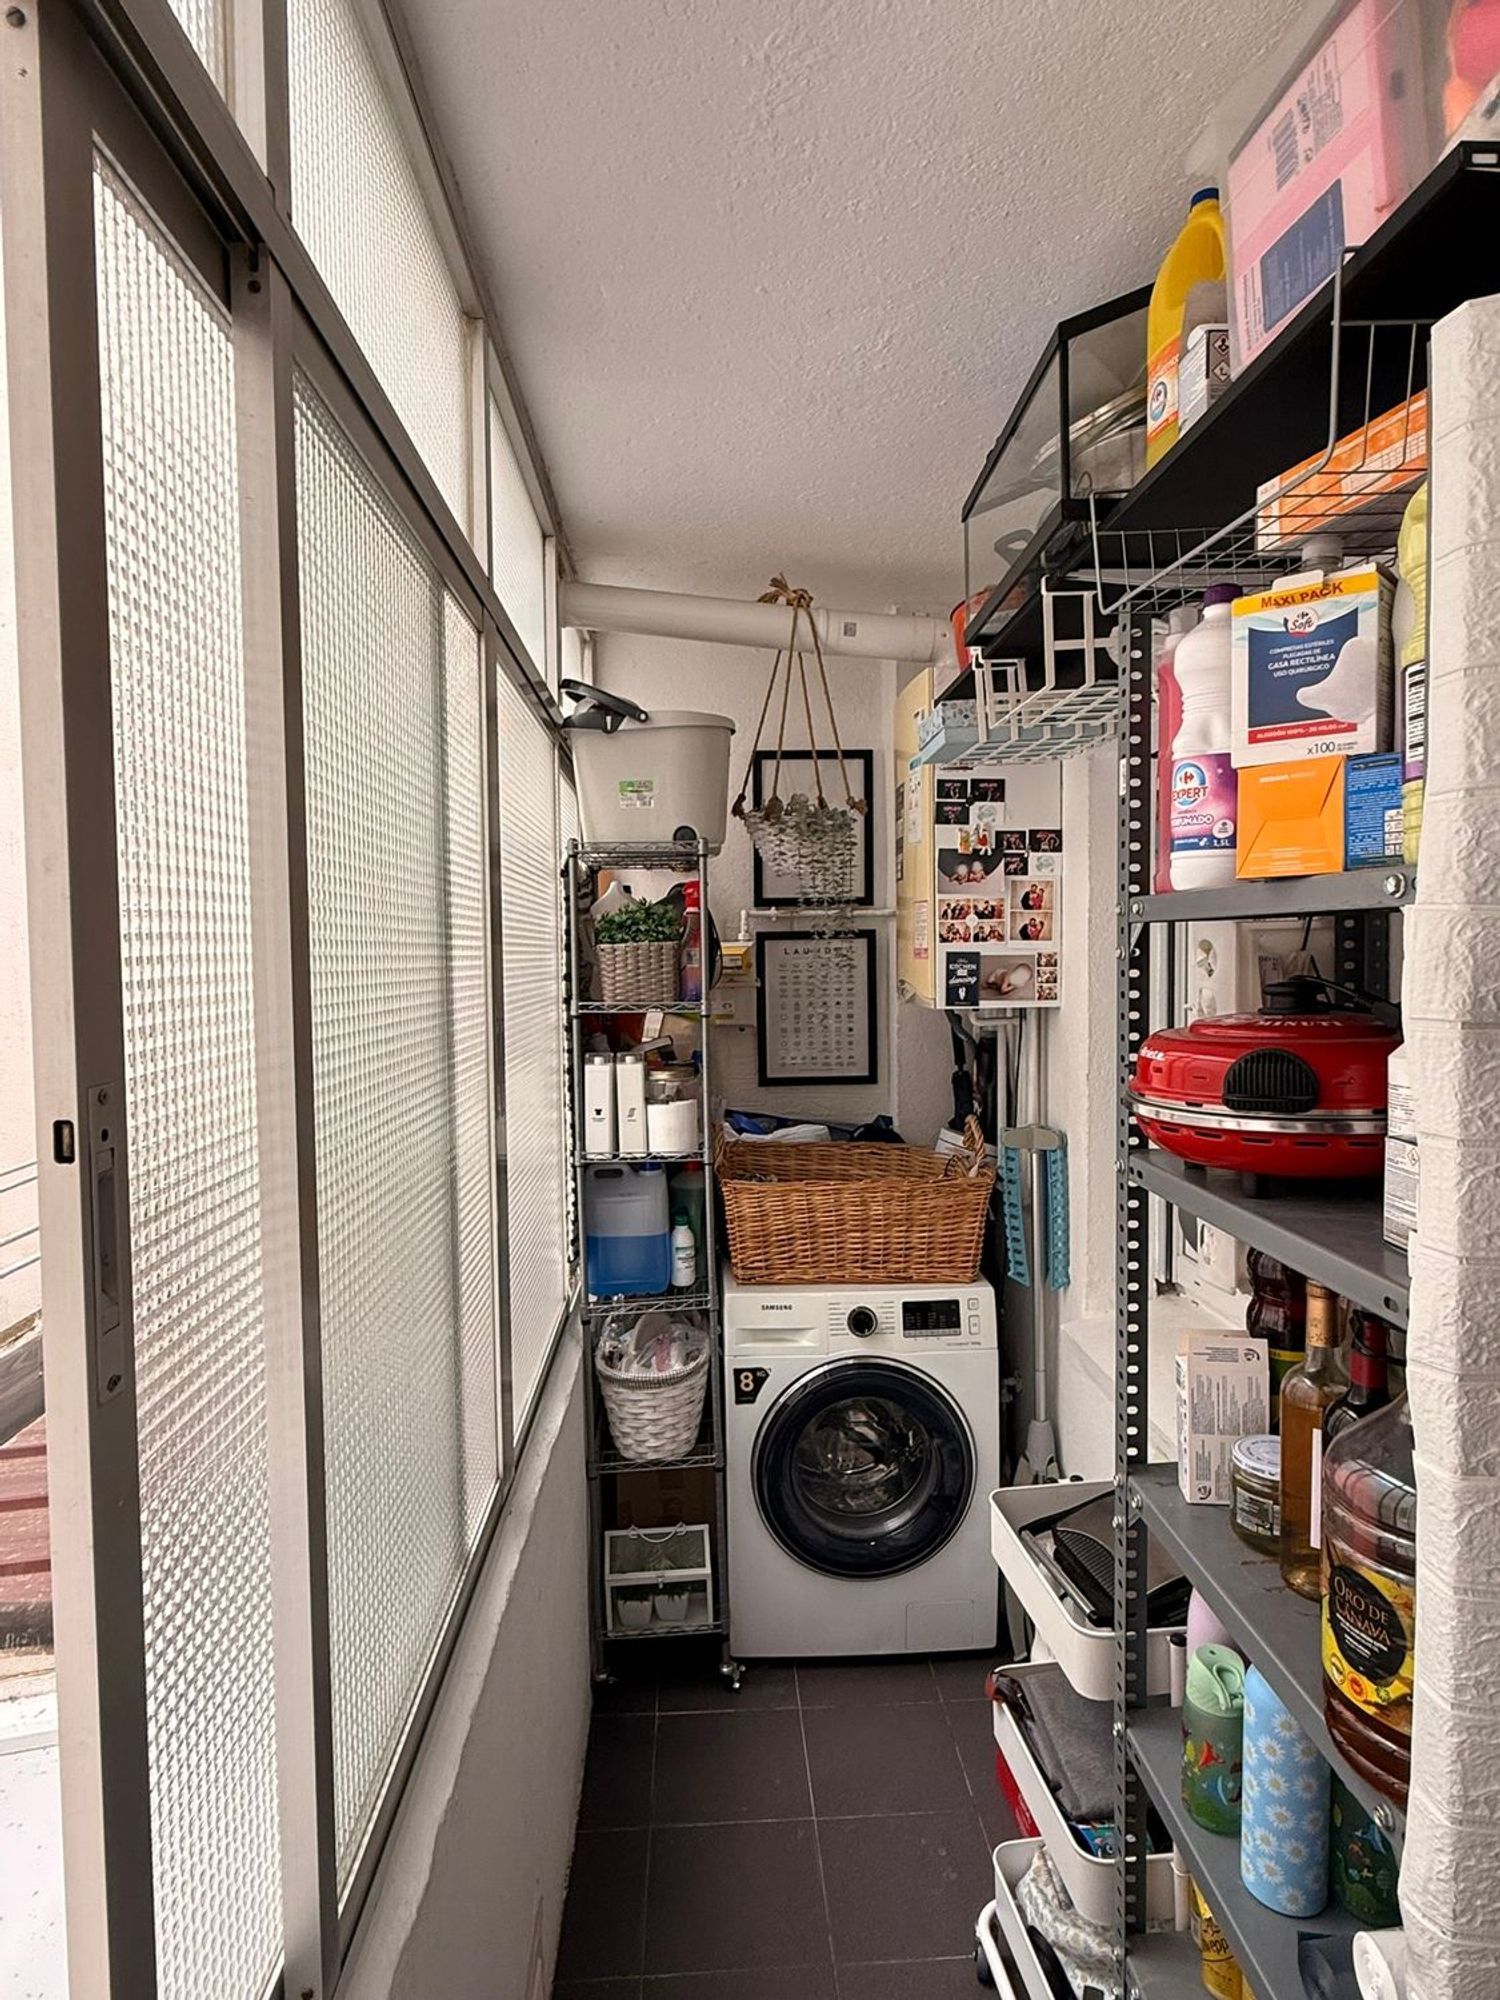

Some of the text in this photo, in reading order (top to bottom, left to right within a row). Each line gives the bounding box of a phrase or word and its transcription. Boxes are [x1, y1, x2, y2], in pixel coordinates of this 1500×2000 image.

[1261, 581, 1344, 609] MAXI PACK
[1290, 616, 1315, 632] Soft
[1289, 653, 1336, 667] RECTILÍNEA
[1273, 669, 1288, 679] USO
[1306, 741, 1336, 755] x100
[740, 1371, 754, 1392] 8
[1334, 1576, 1390, 1626] ORO DE
